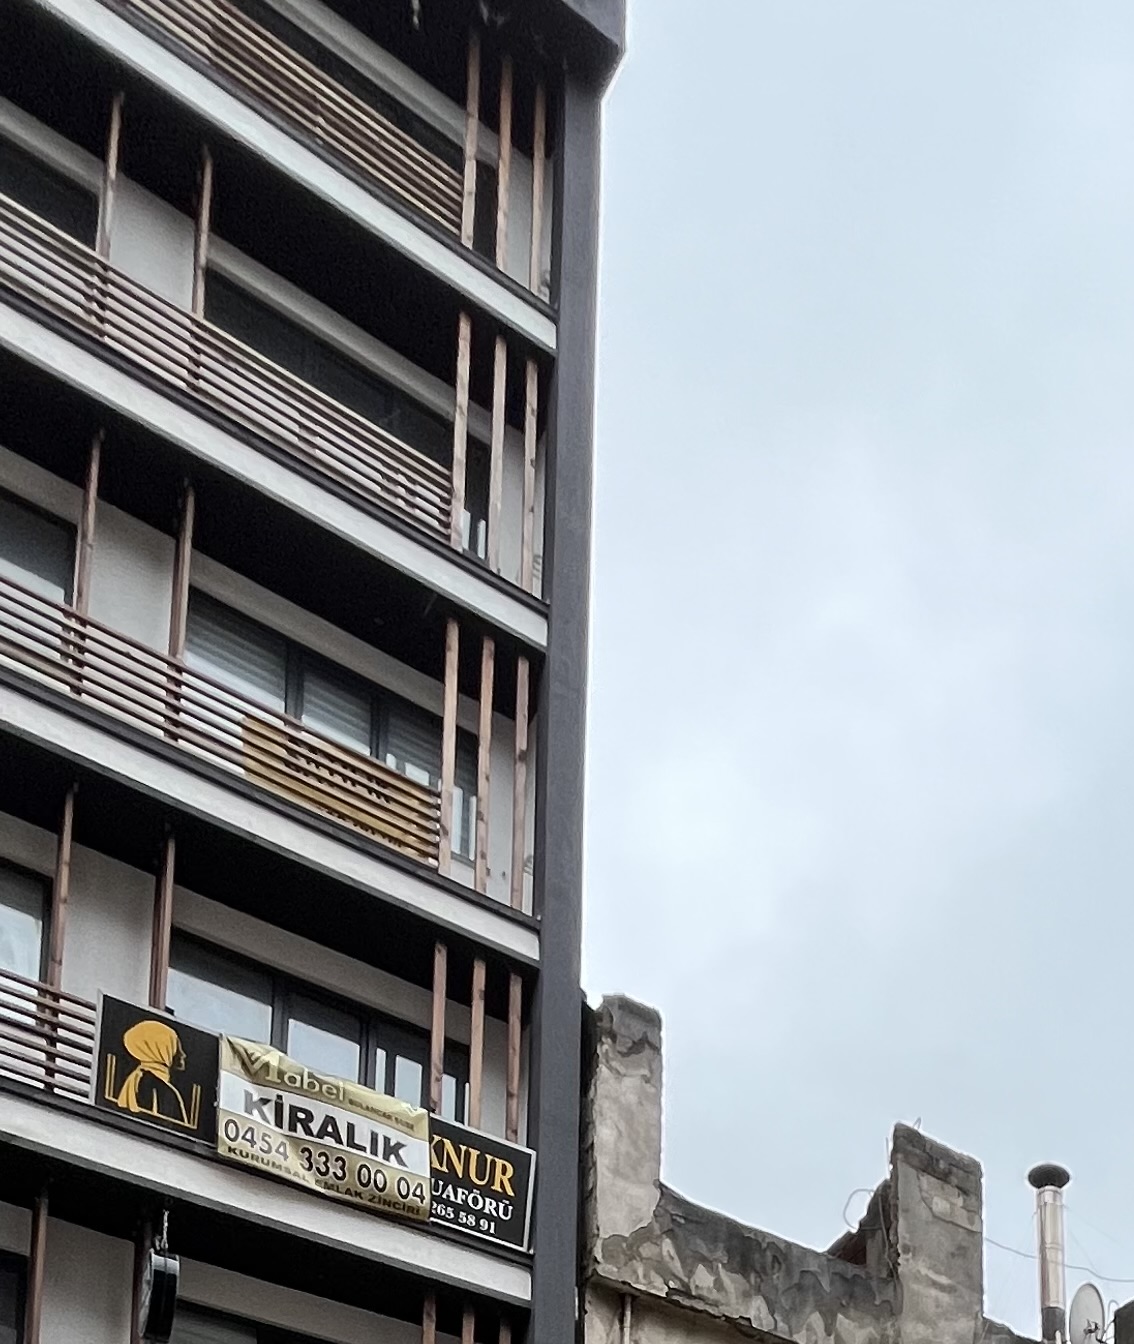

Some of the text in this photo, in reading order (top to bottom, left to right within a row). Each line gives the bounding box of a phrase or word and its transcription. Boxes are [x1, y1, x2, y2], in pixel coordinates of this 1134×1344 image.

[224, 1118, 426, 1204] 0454 333 00 04
[244, 1089, 409, 1168] KİRALIK
[227, 1145, 309, 1183] KURUMSAL
[314, 1178, 363, 1199] EMLAK
[458, 1211, 476, 1227] 58
[480, 1218, 496, 1234] 91
